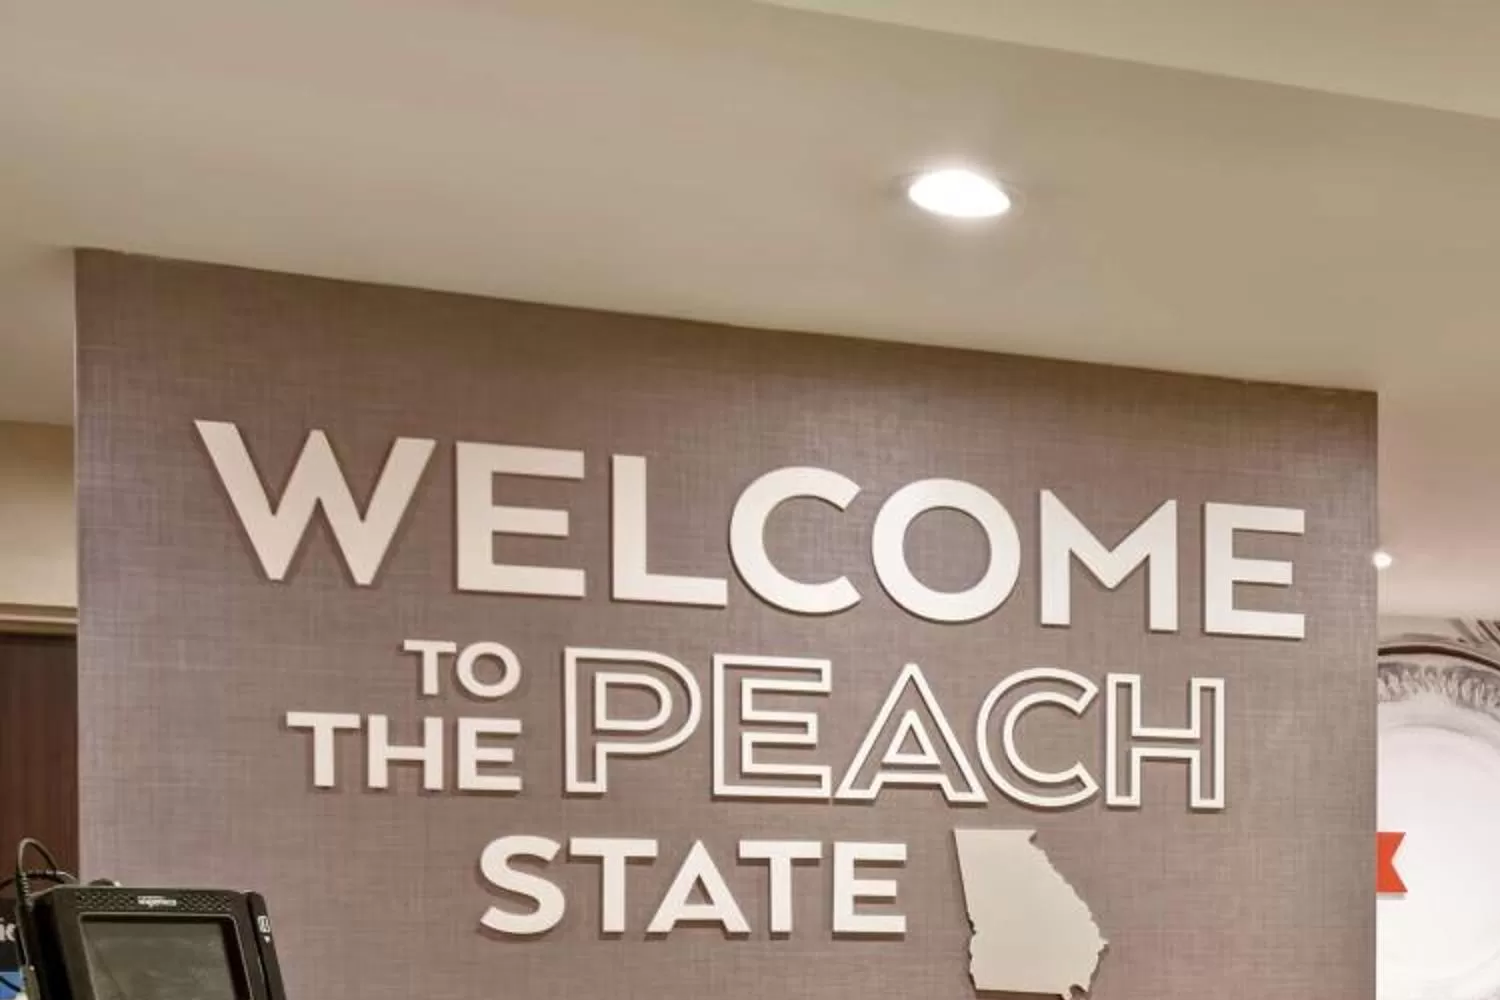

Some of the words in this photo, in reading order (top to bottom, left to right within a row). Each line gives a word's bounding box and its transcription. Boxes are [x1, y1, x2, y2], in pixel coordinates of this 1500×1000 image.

[193, 418, 1307, 640] WELCOME
[402, 638, 522, 699] TO
[285, 710, 523, 792] THE
[563, 646, 1227, 811] PEACH
[478, 834, 908, 938] STATE
